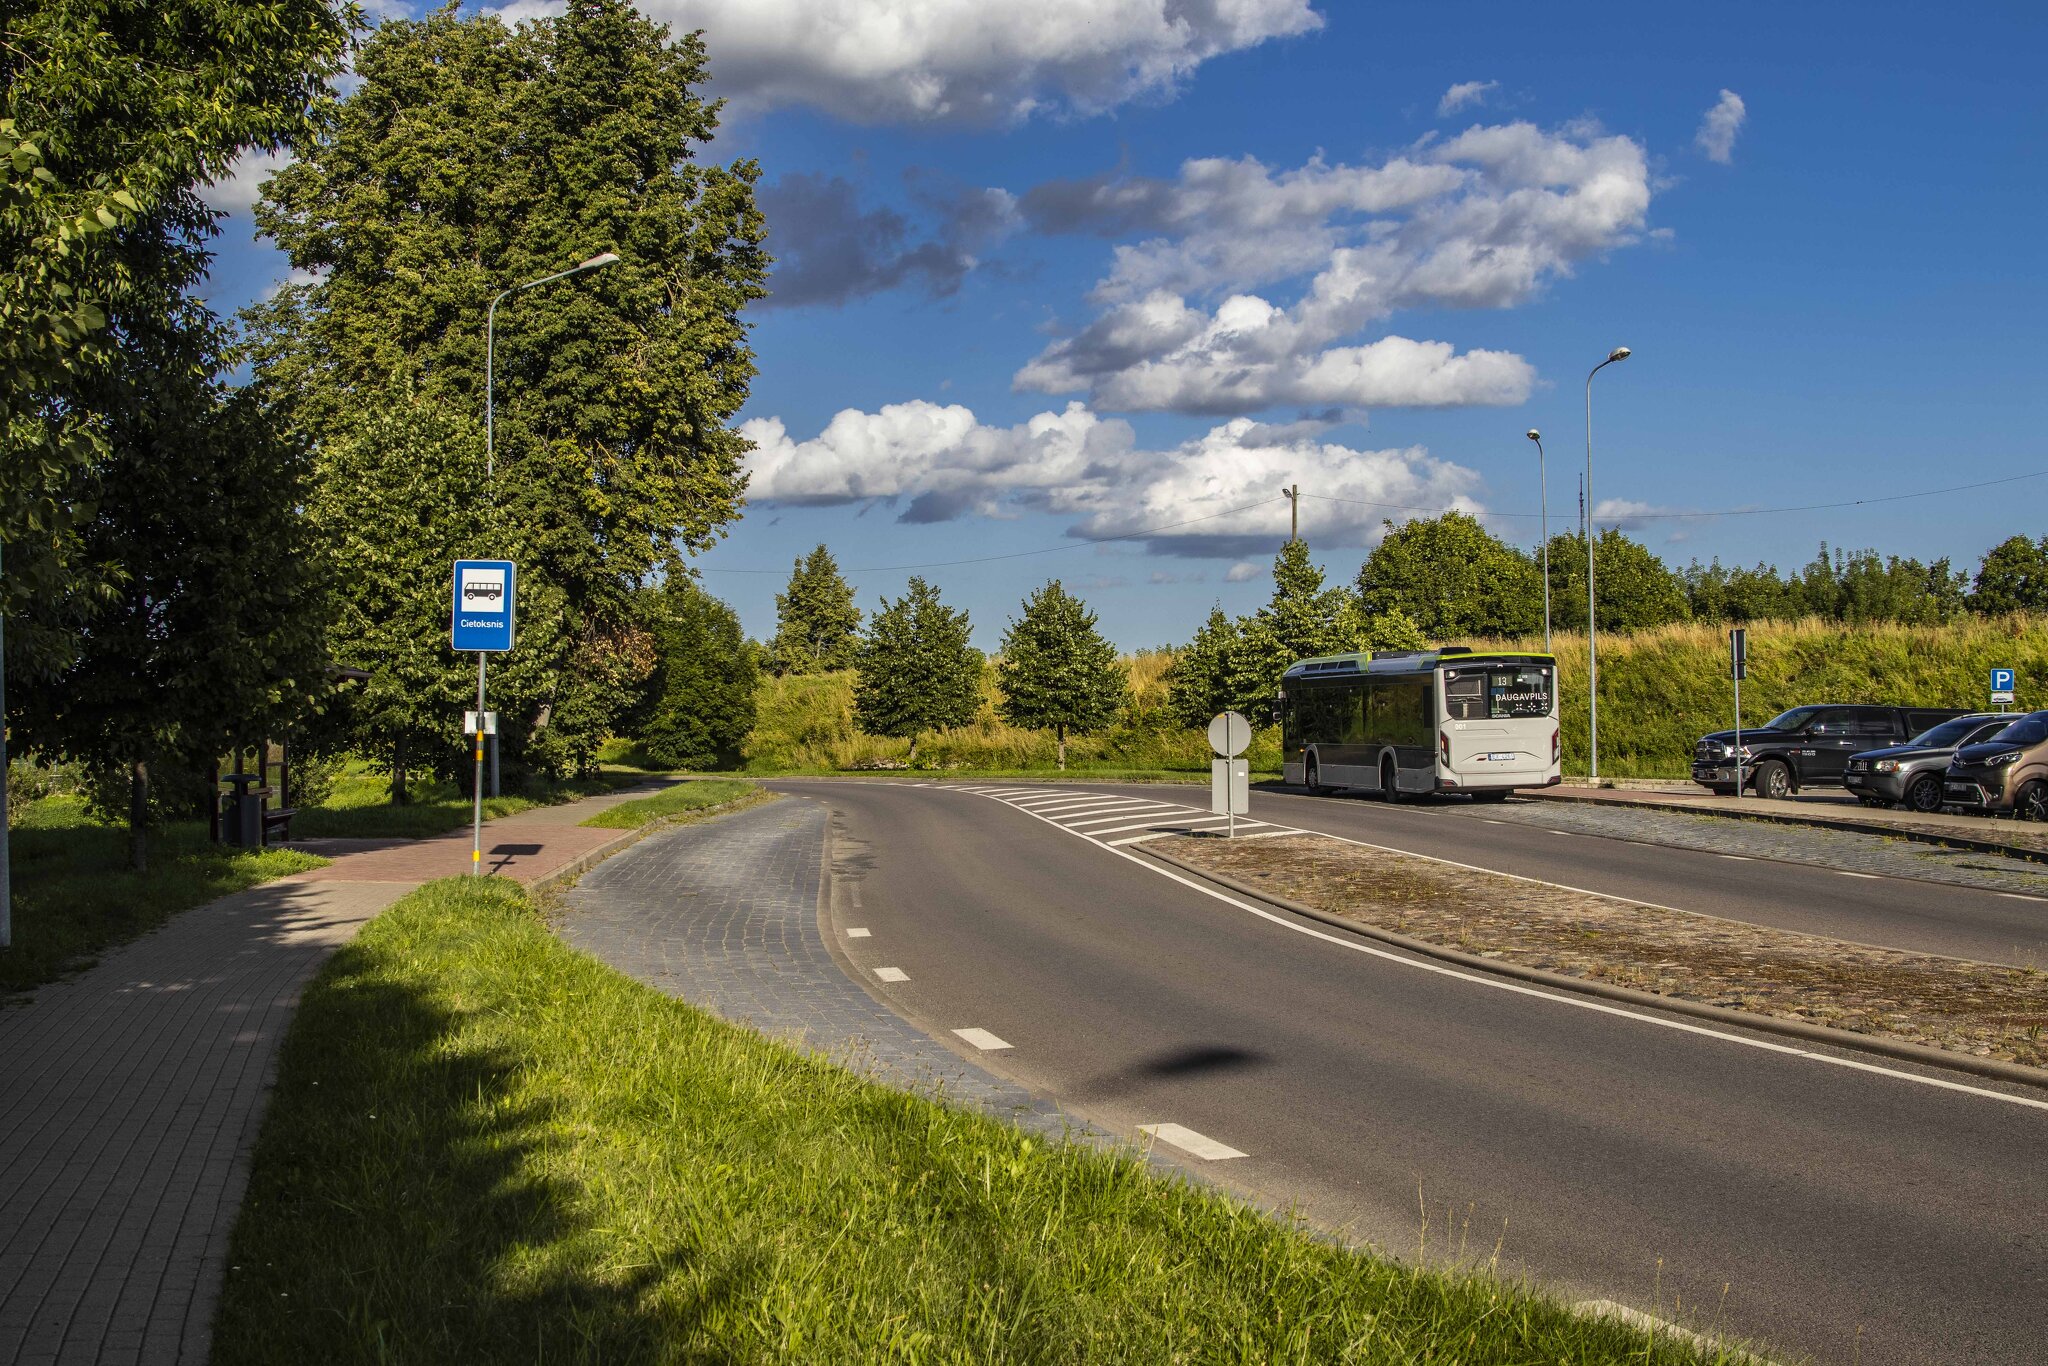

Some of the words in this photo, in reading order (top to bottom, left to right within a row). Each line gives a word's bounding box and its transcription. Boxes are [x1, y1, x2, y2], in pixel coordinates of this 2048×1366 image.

[460, 618, 504, 628] Cietoksnis
[1497, 676, 1507, 686] 13
[1996, 671, 2010, 689] P
[1495, 692, 1548, 702] DAUGAVPILS
